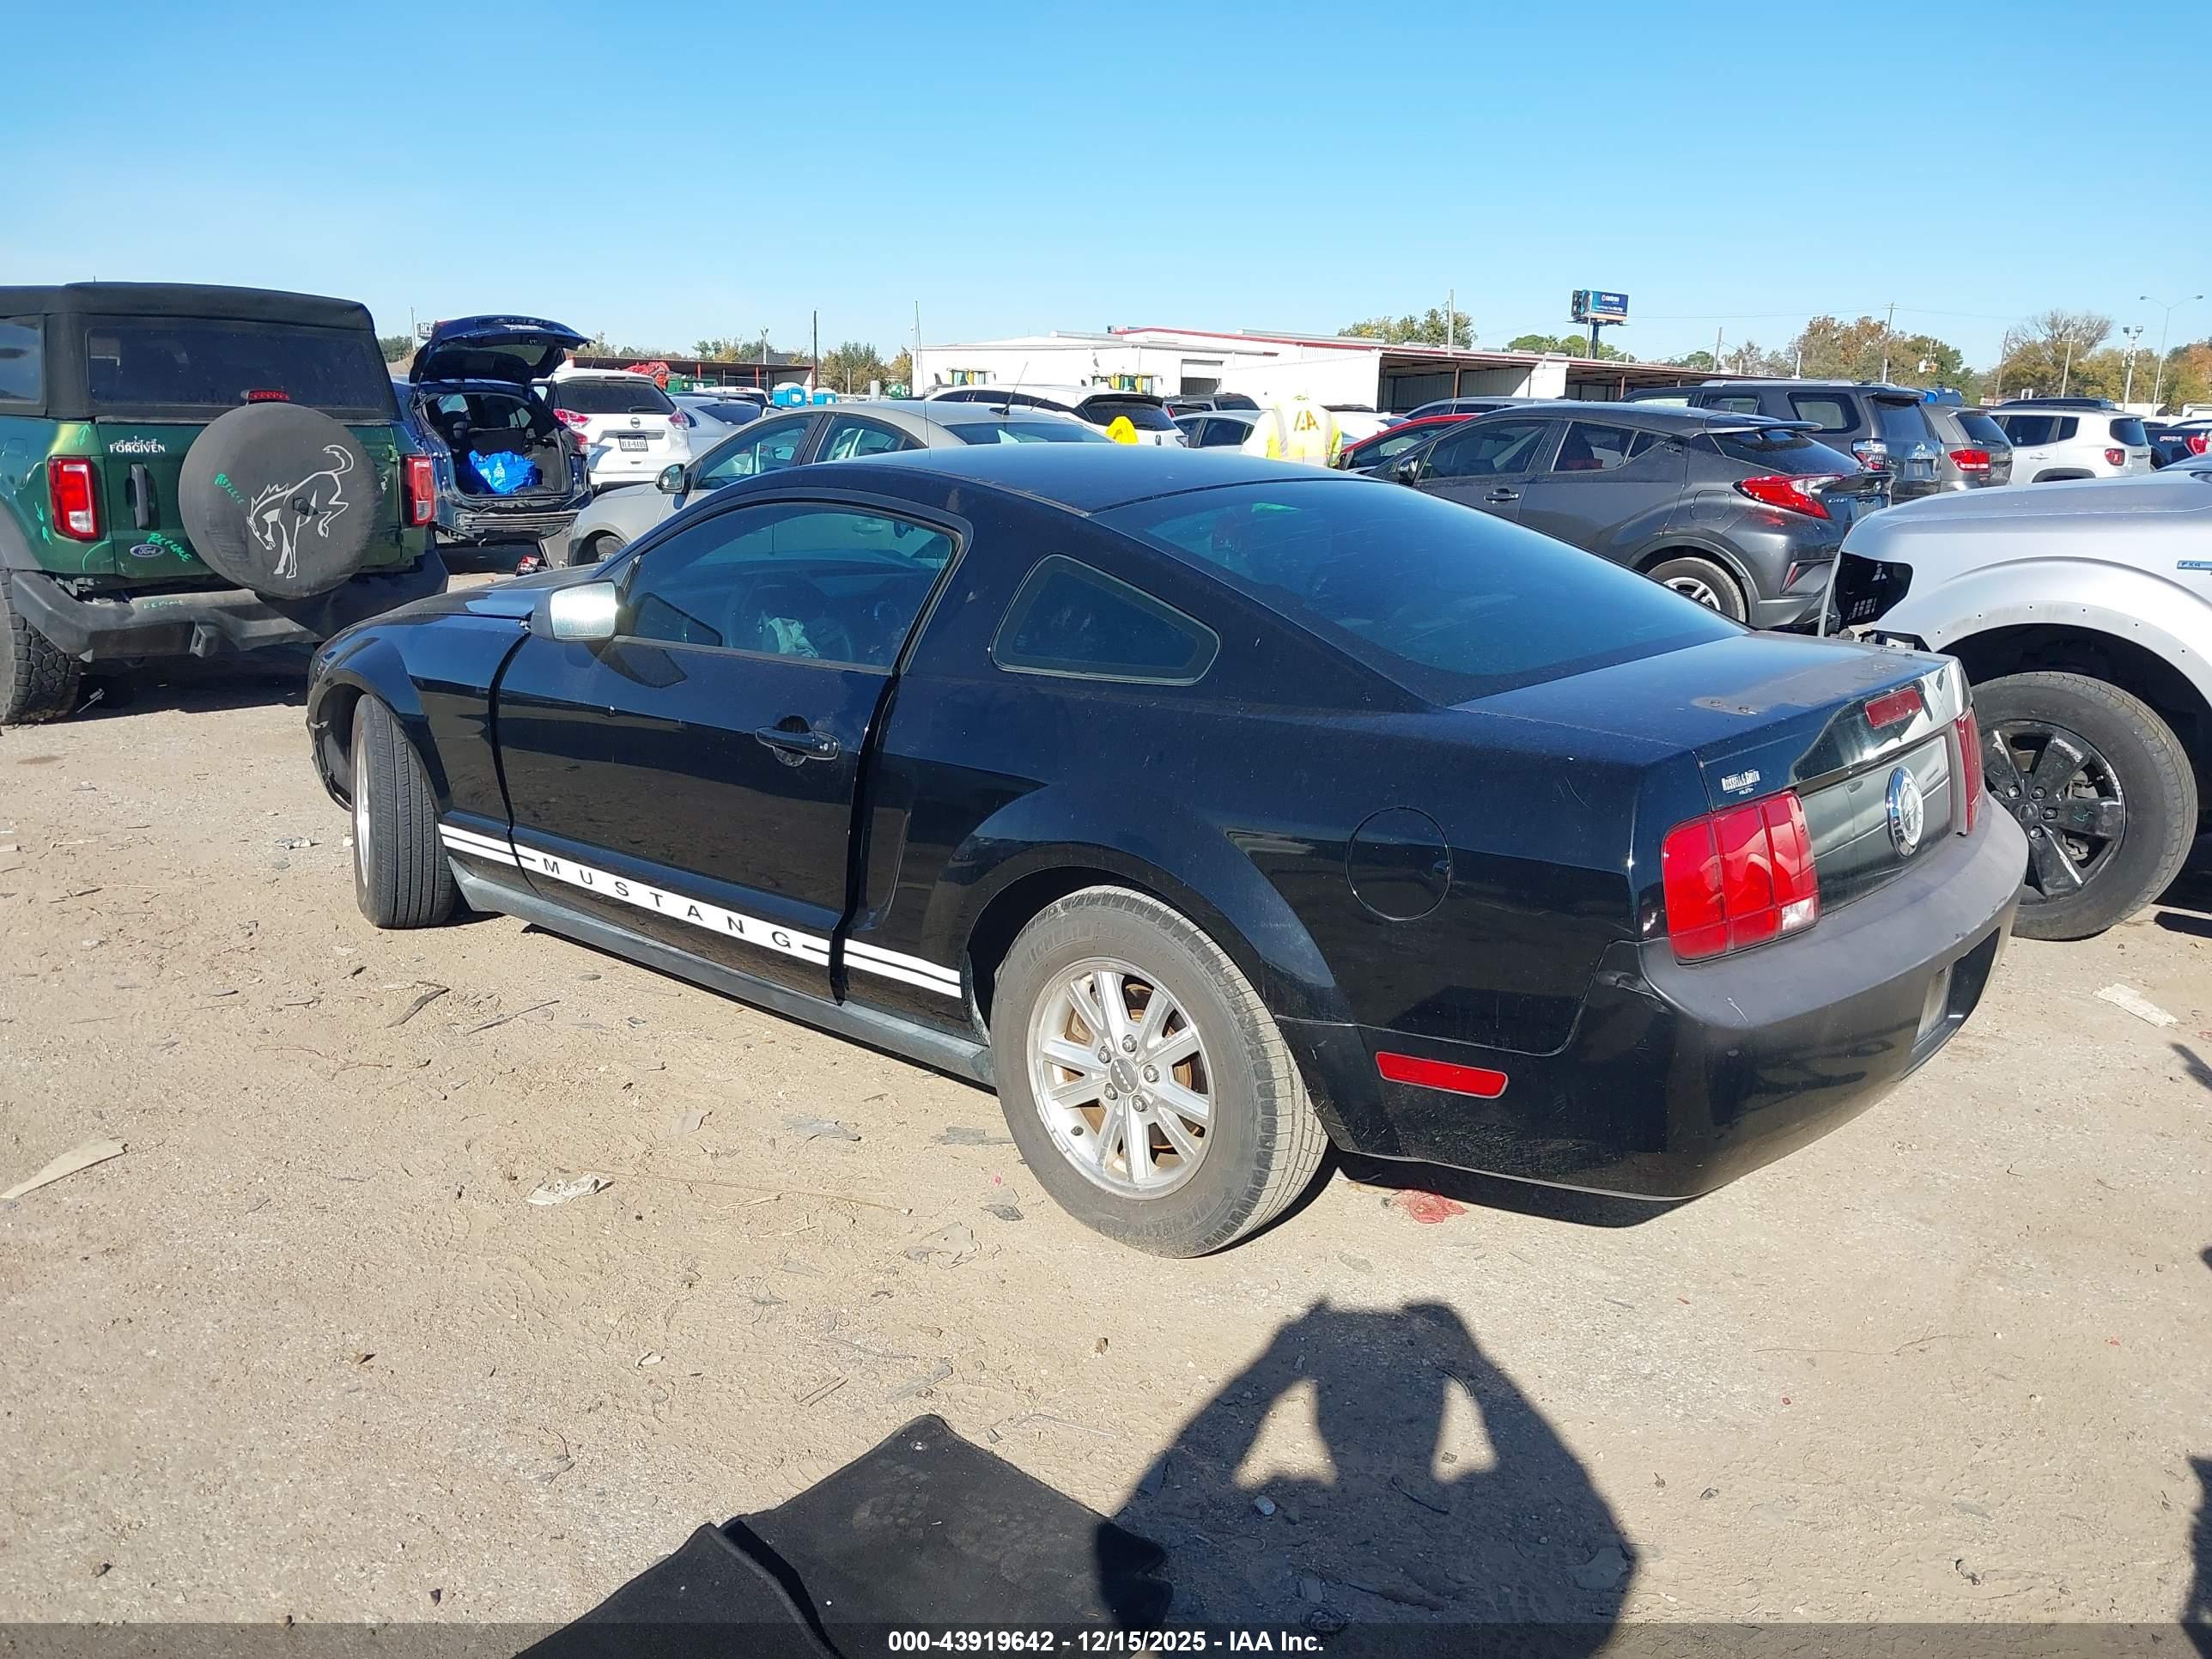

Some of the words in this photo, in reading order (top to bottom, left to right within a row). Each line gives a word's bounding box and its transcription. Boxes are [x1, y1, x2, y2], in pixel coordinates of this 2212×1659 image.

[109, 444, 166, 453] FORGIVEN
[137, 546, 157, 555] Ford
[543, 857, 793, 949] MUSTANG
